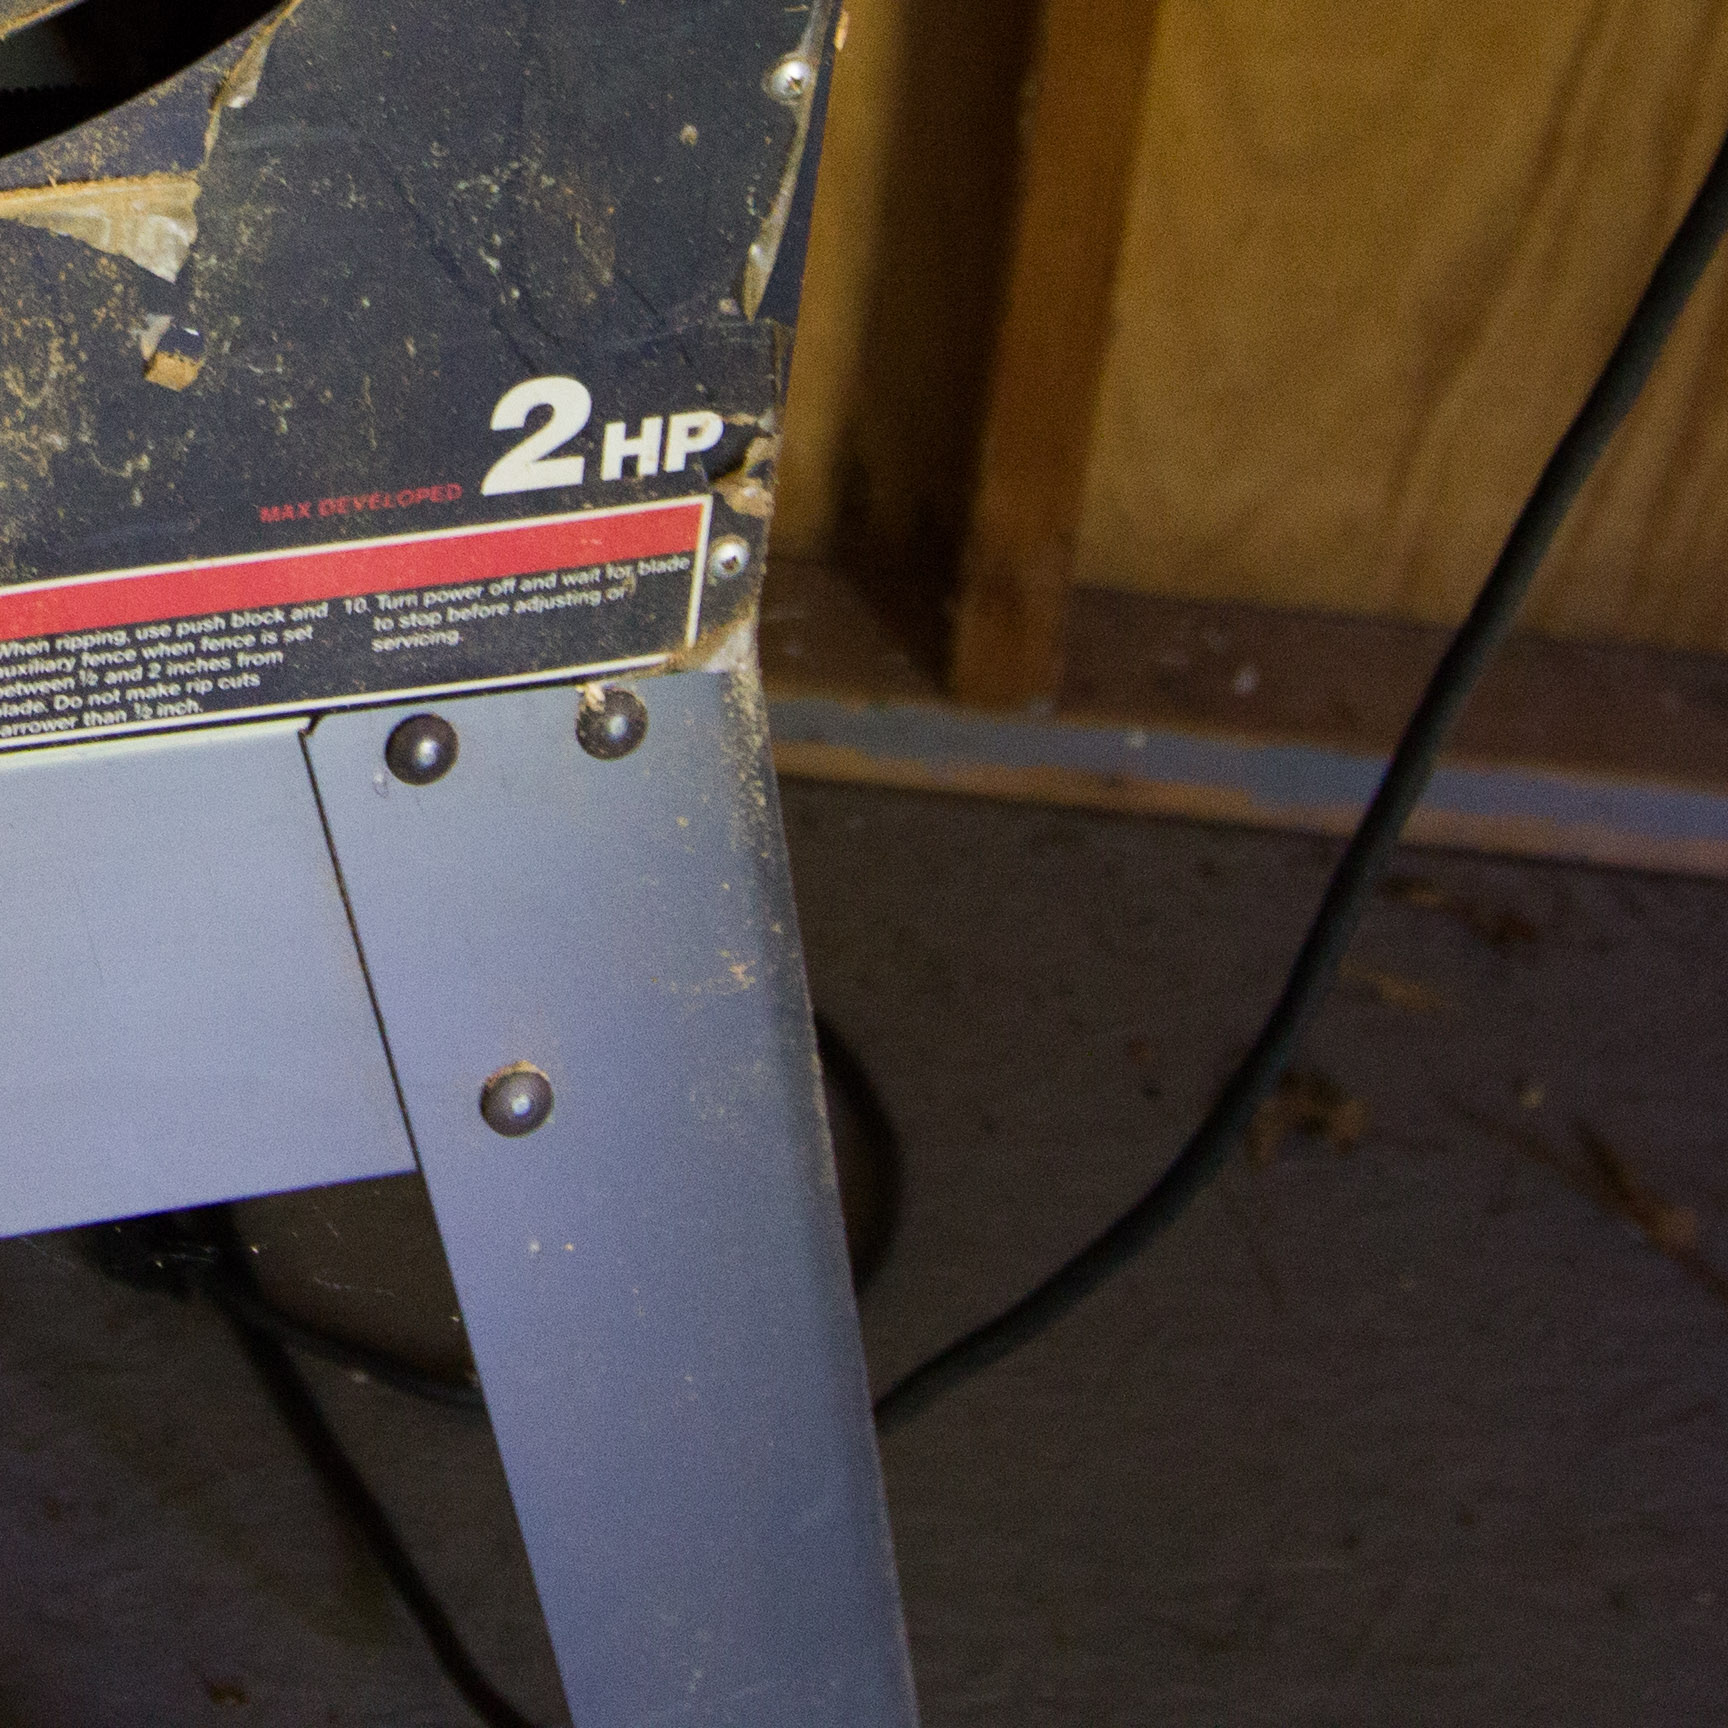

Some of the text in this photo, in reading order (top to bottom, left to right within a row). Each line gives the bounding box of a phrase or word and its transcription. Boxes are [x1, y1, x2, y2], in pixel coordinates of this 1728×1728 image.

[480, 375, 724, 497] 2 HP
[259, 483, 462, 524] MAX DEVELOPED
[375, 593, 418, 612] Turn
[423, 585, 484, 608] power
[488, 578, 516, 597] off
[518, 573, 557, 593] and
[561, 568, 601, 587] wait
[605, 563, 633, 581] for
[637, 555, 690, 576] blade
[135, 625, 172, 641] use
[176, 616, 226, 639] push
[231, 608, 286, 629] block
[290, 602, 328, 622] and
[373, 587, 625, 632] to stop before adjusting or
[81, 649, 137, 668] fence
[141, 642, 195, 660] when
[200, 635, 256, 653] fence
[260, 629, 278, 646] is
[282, 625, 313, 646] set
[104, 665, 143, 685] and
[148, 662, 161, 680] 2
[166, 657, 232, 677] inches
[236, 651, 284, 668] from
[53, 694, 83, 712] Do
[88, 688, 120, 706] not
[125, 682, 181, 702] make
[186, 677, 213, 696] rip
[217, 673, 261, 690] cuts
[83, 710, 127, 728] than
[156, 698, 204, 718] inch.
